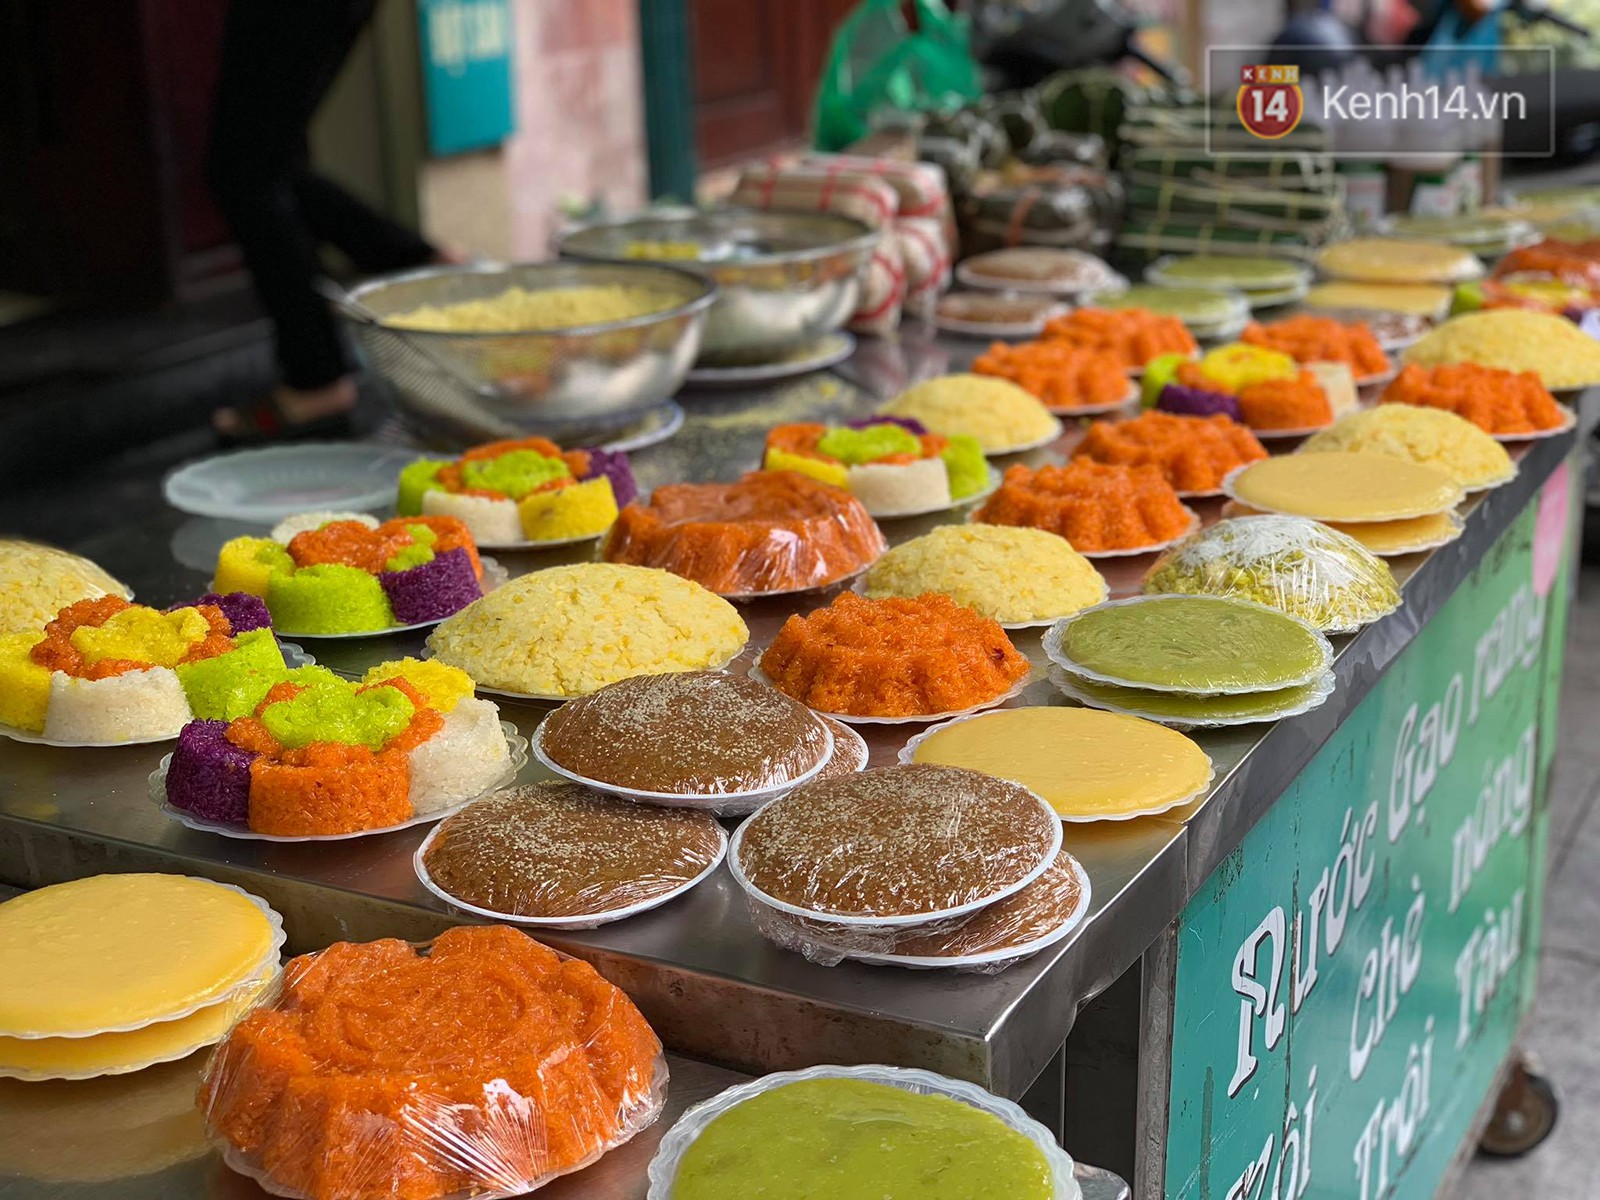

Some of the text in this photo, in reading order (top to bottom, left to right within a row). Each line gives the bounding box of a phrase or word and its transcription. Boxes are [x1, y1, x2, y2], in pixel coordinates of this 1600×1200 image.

[1228, 800, 1379, 1098] Nước
[1388, 672, 1463, 843] Gạo
[1349, 874, 1425, 1081] Chè
[1447, 721, 1537, 913] nóng
